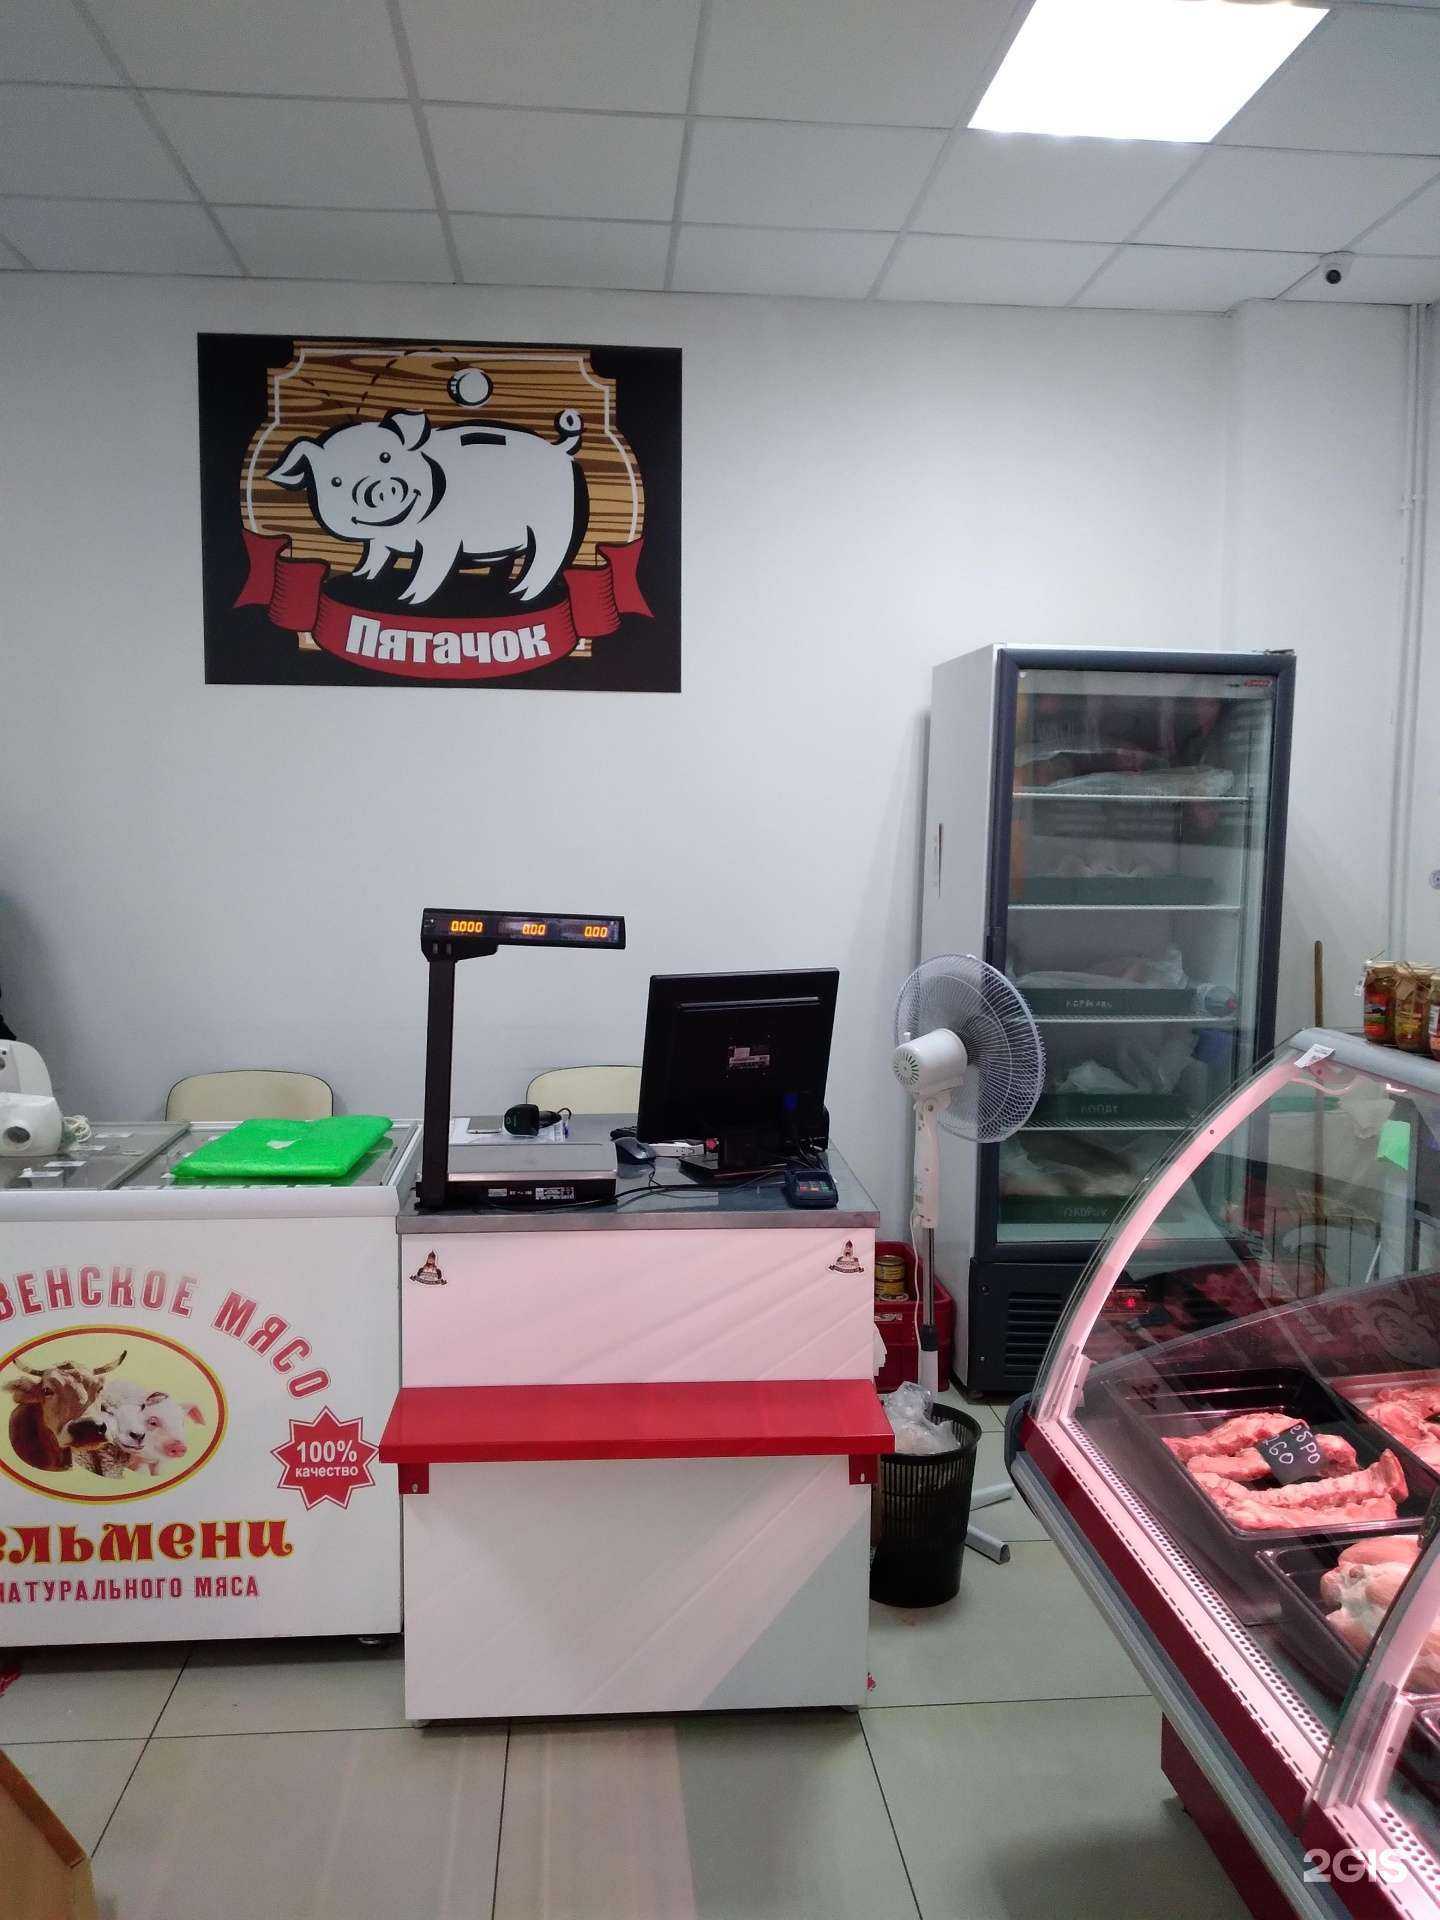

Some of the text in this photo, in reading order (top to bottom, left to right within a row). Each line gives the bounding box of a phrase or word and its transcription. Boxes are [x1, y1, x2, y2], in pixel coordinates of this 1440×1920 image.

[346, 615, 552, 664] Пятачок
[211, 1288, 331, 1399] МЯСО
[296, 1440, 358, 1463] 100%
[295, 1465, 359, 1478] качество
[0, 1519, 293, 1565] льмени
[194, 1575, 260, 1599] МЯСА
